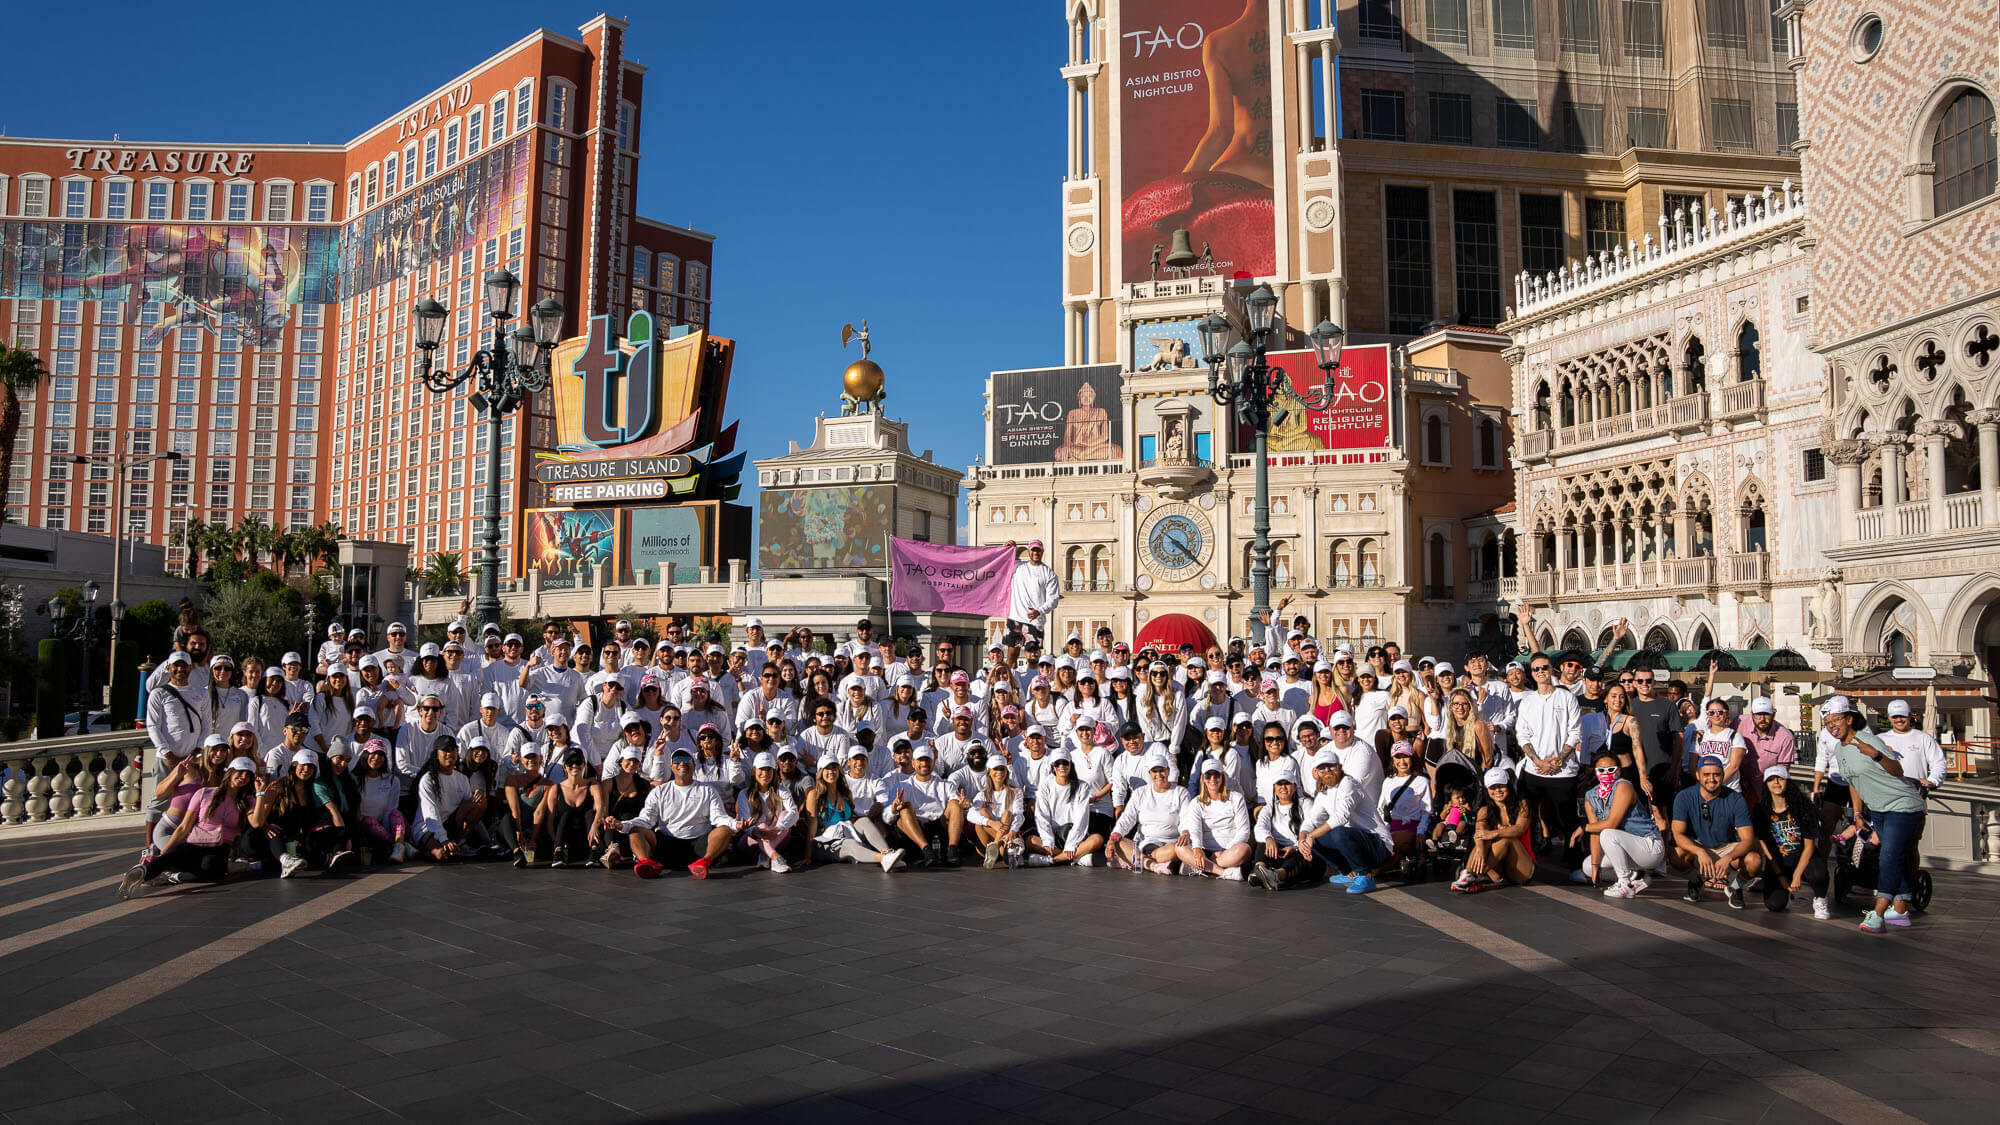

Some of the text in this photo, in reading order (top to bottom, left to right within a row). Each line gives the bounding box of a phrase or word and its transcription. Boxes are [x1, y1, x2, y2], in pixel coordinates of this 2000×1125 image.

[1122, 22, 1204, 58] TAO
[1125, 68, 1201, 87] ASIAN BISTRO
[1133, 83, 1194, 99] NIGHTCLUB
[396, 82, 472, 143] ISLAND
[66, 148, 254, 177] TREASURE
[420, 192, 434, 208] DU
[434, 176, 465, 201] SOLEIL
[1163, 260, 1234, 273] TAOVEGS.COM
[1308, 380, 1385, 407] TAO
[996, 400, 1063, 425] TAO
[1312, 414, 1383, 425] RELIGIOUS
[1322, 407, 1373, 415] NGHTCLUB
[1314, 421, 1382, 432] NIGHTLIFE
[1001, 432, 1060, 442] SPIRITUAL
[1009, 439, 1050, 448] DINING
[547, 457, 681, 480] TREASURE ISLAND
[555, 482, 664, 501] FREE PARKING
[641, 534, 691, 548] Millions of
[903, 563, 996, 582] TAO GROUP
[543, 579, 565, 588] CIRQUE
[921, 580, 974, 590] HOSPITALITY
